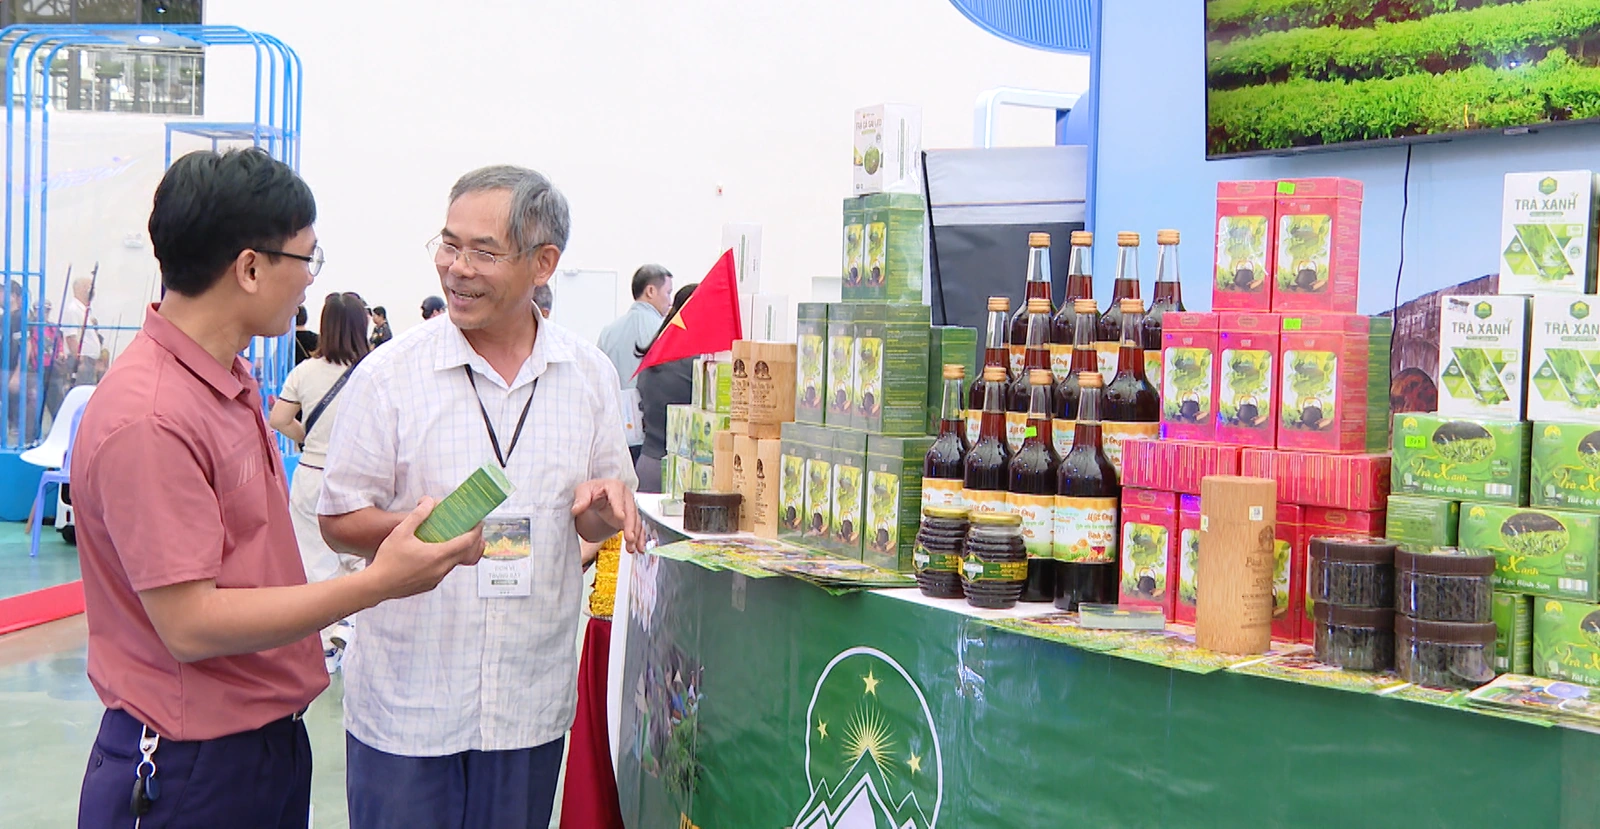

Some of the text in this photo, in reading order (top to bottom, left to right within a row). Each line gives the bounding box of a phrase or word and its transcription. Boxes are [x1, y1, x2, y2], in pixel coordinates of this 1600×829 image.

[1515, 196, 1576, 210] TRÀ XANH
[1452, 321, 1511, 335] TRÀ XANH
[1545, 321, 1569, 334] TRÀ
[1433, 463, 1468, 482] Xanh
[1502, 555, 1539, 575] Xanh
